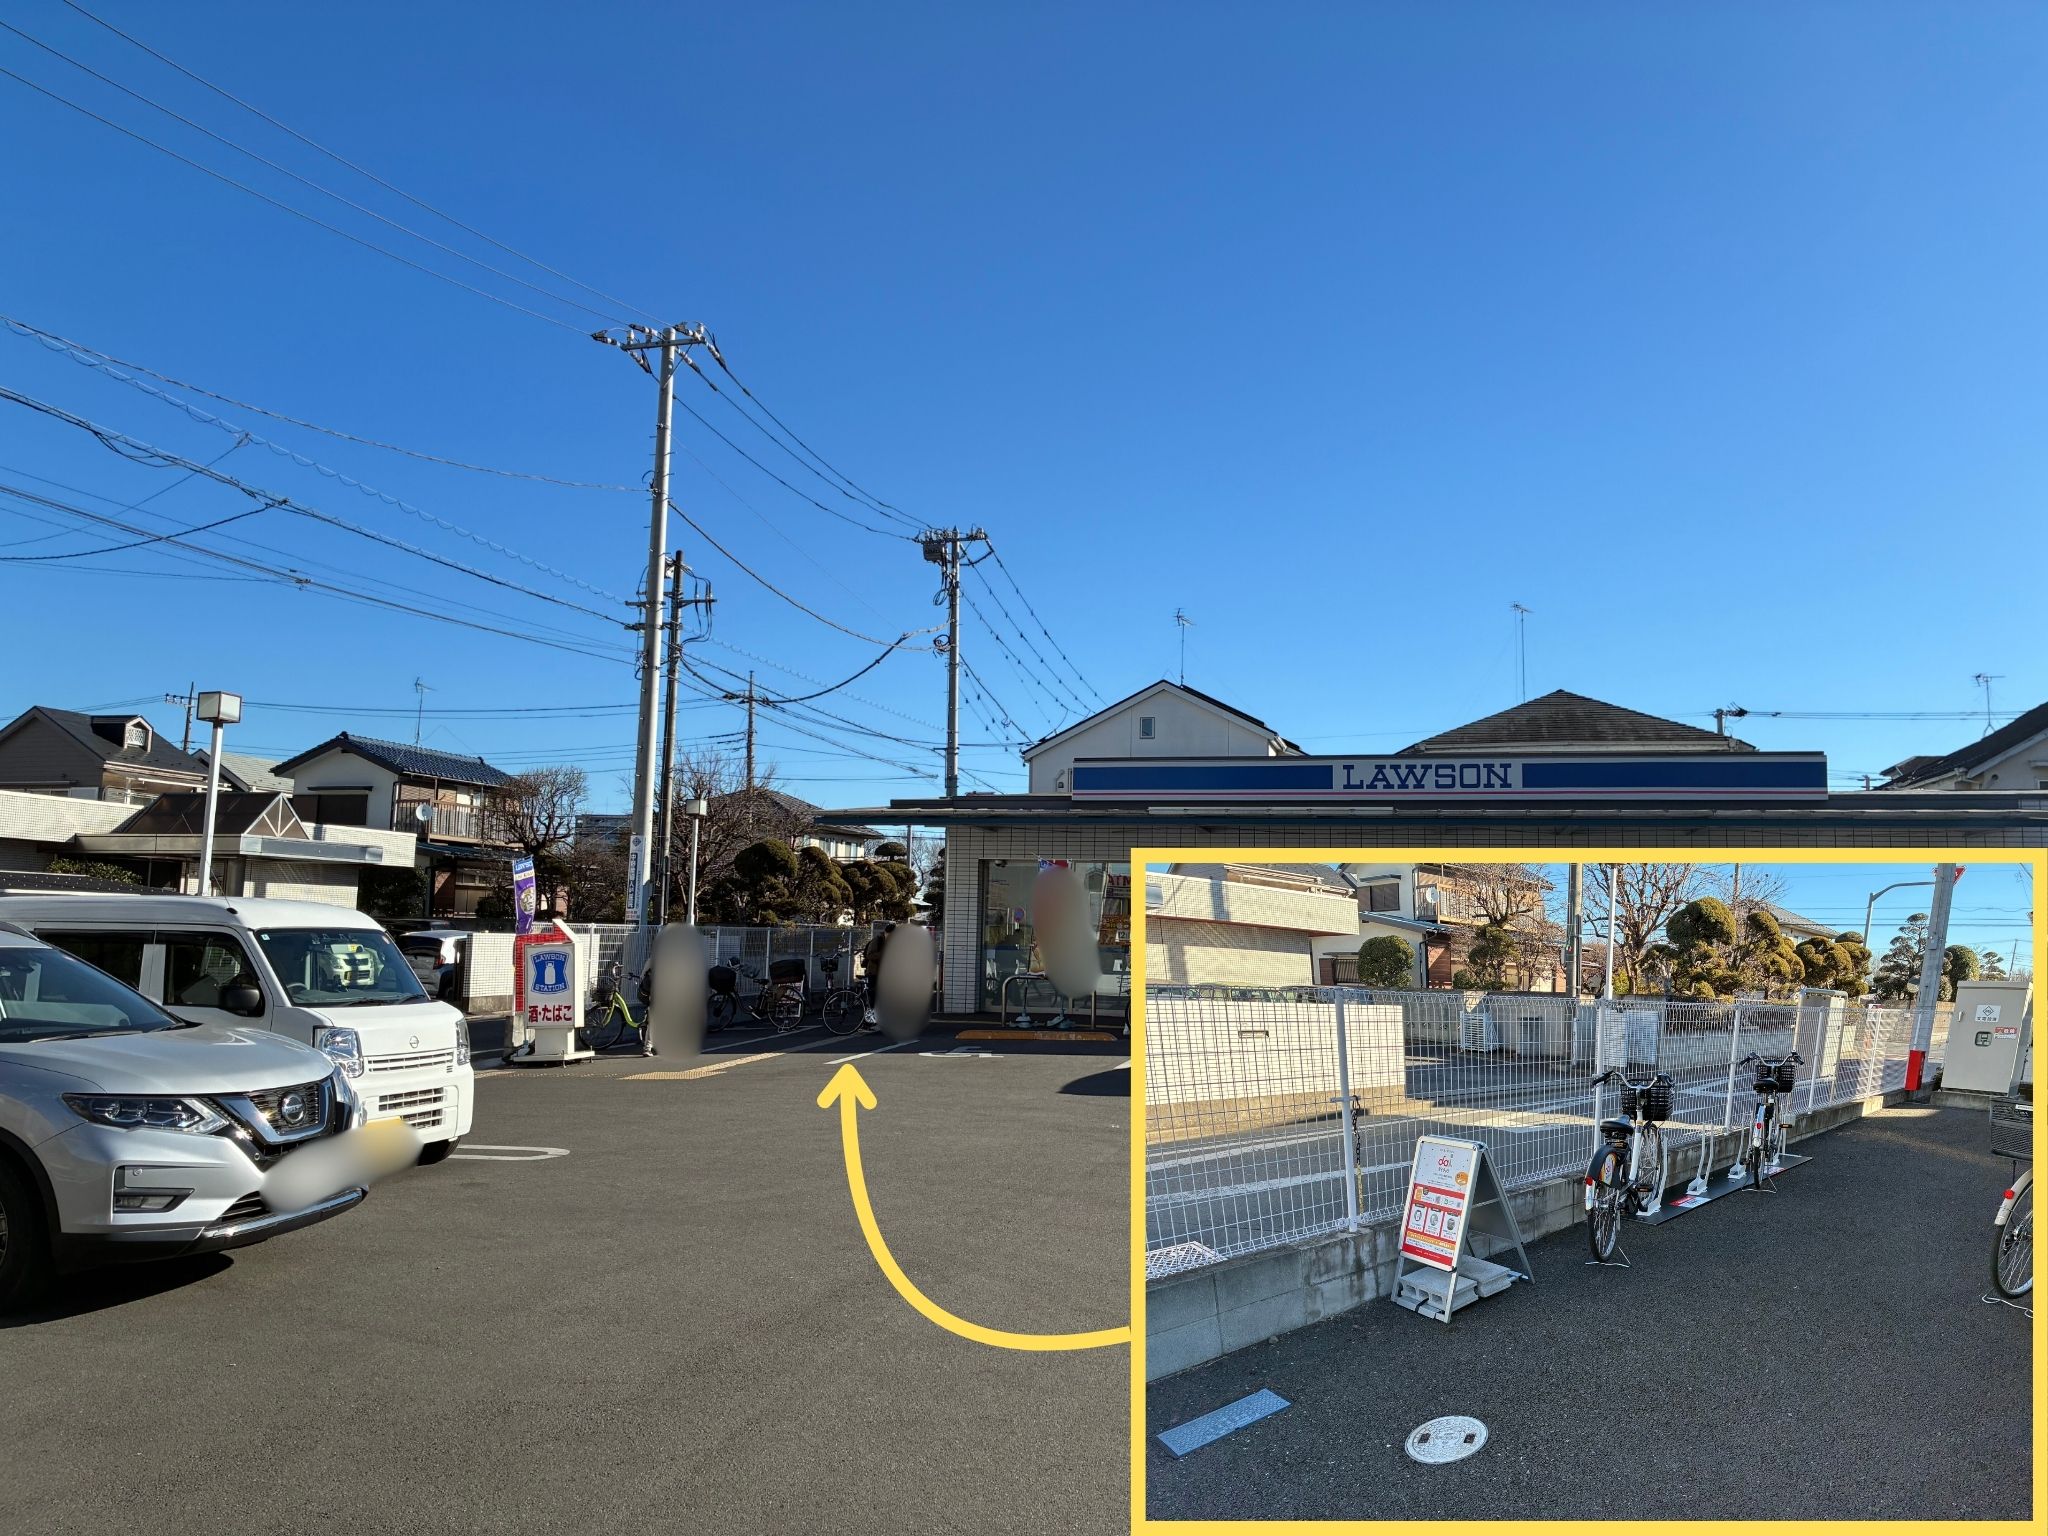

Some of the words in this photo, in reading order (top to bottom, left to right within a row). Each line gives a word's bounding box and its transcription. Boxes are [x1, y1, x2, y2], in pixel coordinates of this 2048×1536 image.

[1342, 762, 1513, 790] LAWSON
[534, 953, 566, 963] LAWSON
[534, 982, 565, 992] STATION
